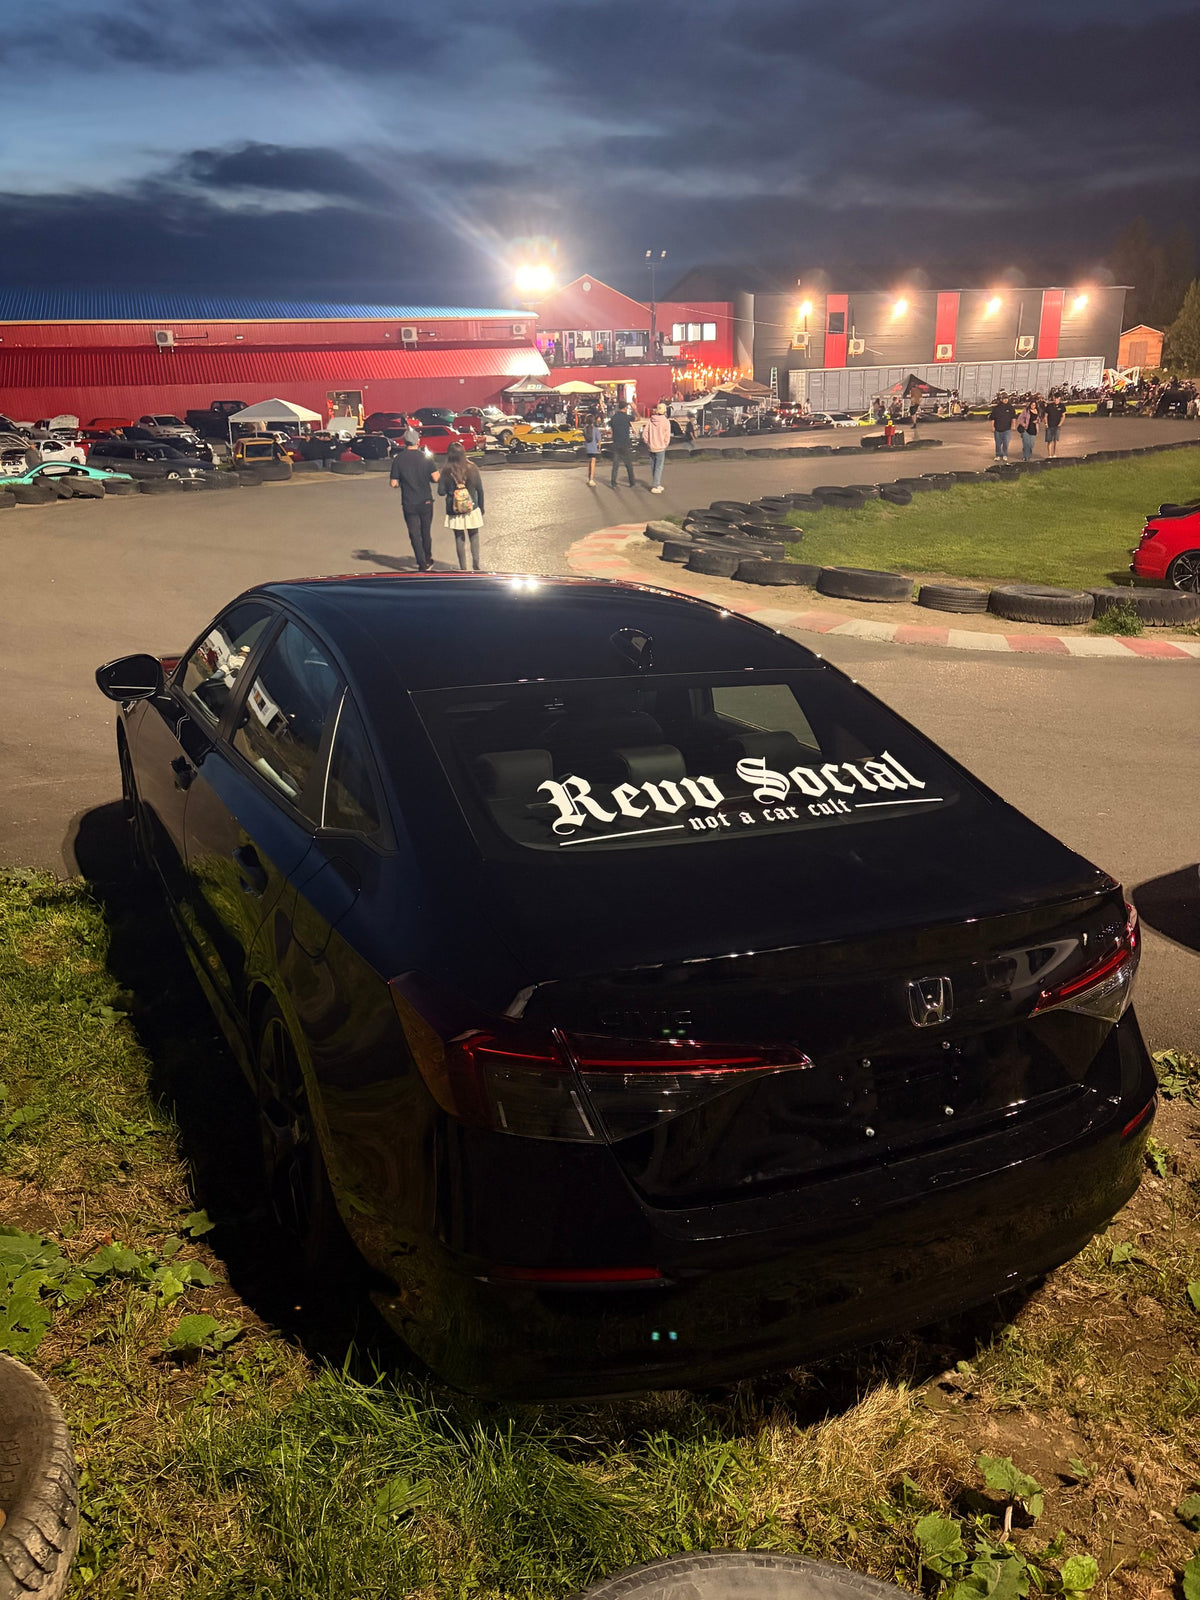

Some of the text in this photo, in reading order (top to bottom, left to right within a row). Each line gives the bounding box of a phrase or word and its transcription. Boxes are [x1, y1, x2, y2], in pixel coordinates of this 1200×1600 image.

[536, 750, 926, 836] Revv Social
[688, 797, 852, 831] not a car cult
